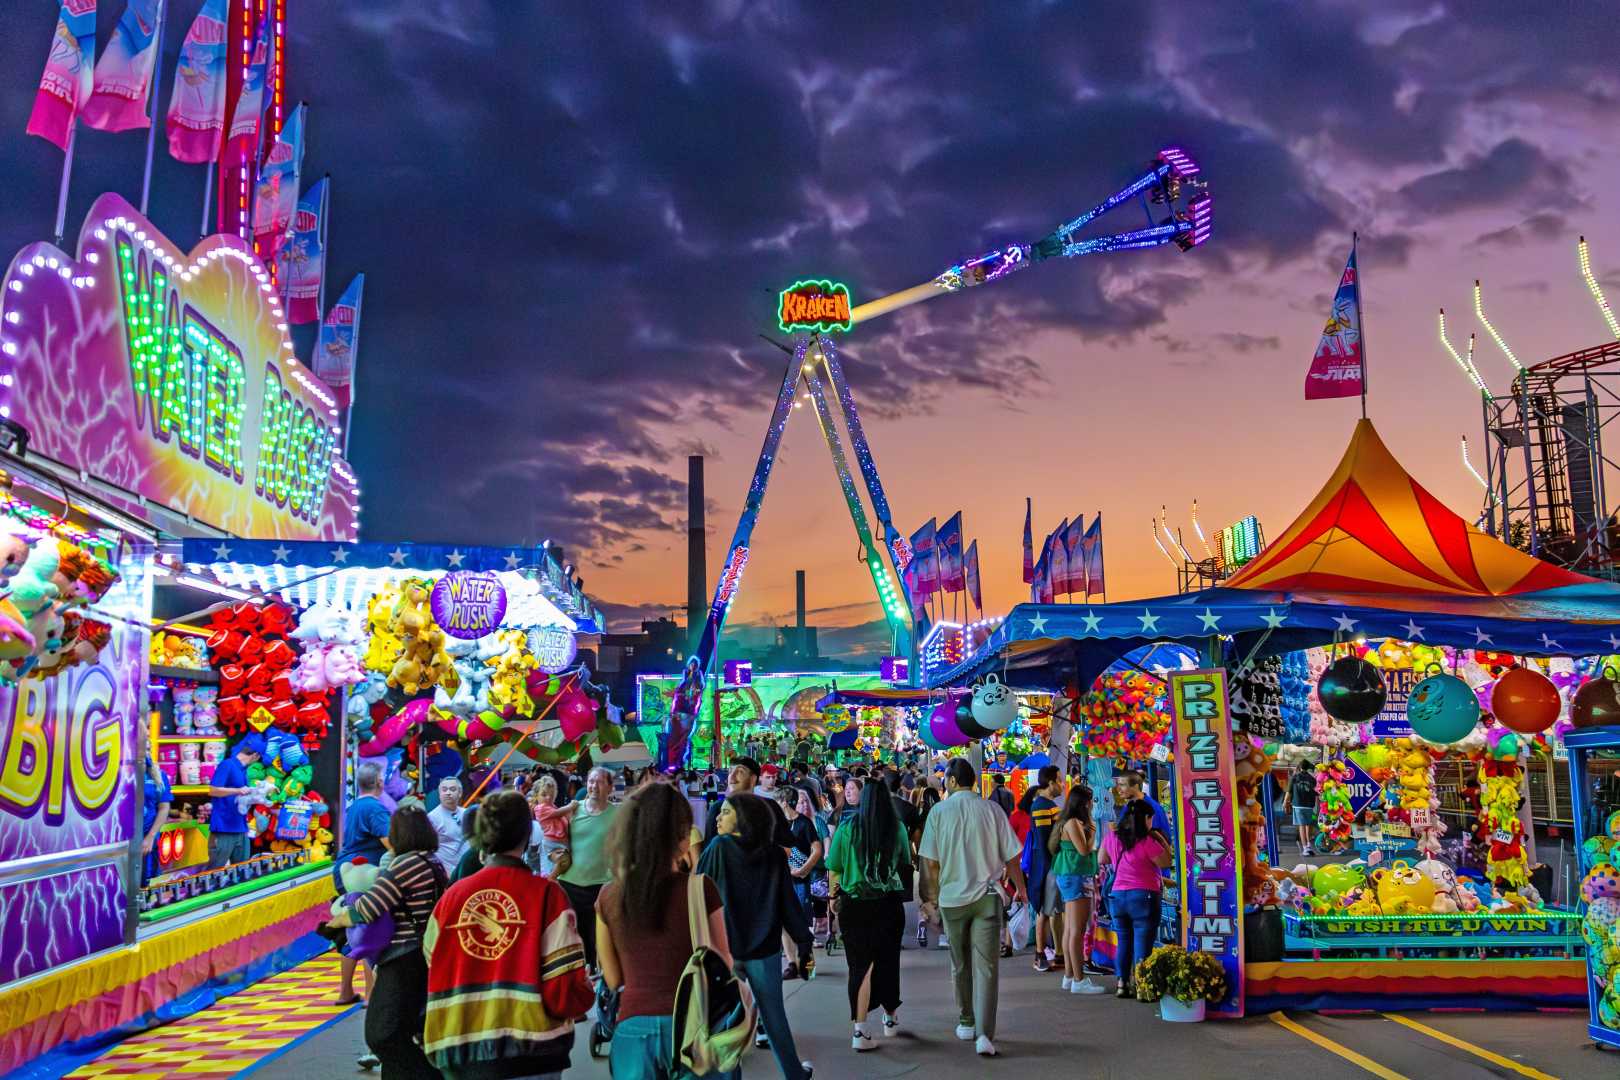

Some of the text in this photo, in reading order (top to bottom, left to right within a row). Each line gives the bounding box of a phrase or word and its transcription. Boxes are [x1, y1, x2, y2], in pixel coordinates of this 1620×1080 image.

[783, 291, 850, 322] KRAKEN
[115, 230, 335, 526] WATER RUSH
[448, 576, 495, 602] WATER
[449, 603, 490, 630] RUSH
[537, 630, 568, 648] WATER
[537, 648, 568, 667] RUSH
[0, 671, 122, 816] BIG
[1183, 683, 1232, 952] PRIZE EVERY TIME
[1413, 817, 1428, 825] WIN
[461, 892, 501, 919] WNSTON
[1328, 919, 1400, 933] FISH
[1462, 919, 1480, 932] U
[1490, 919, 1547, 932] WIN
